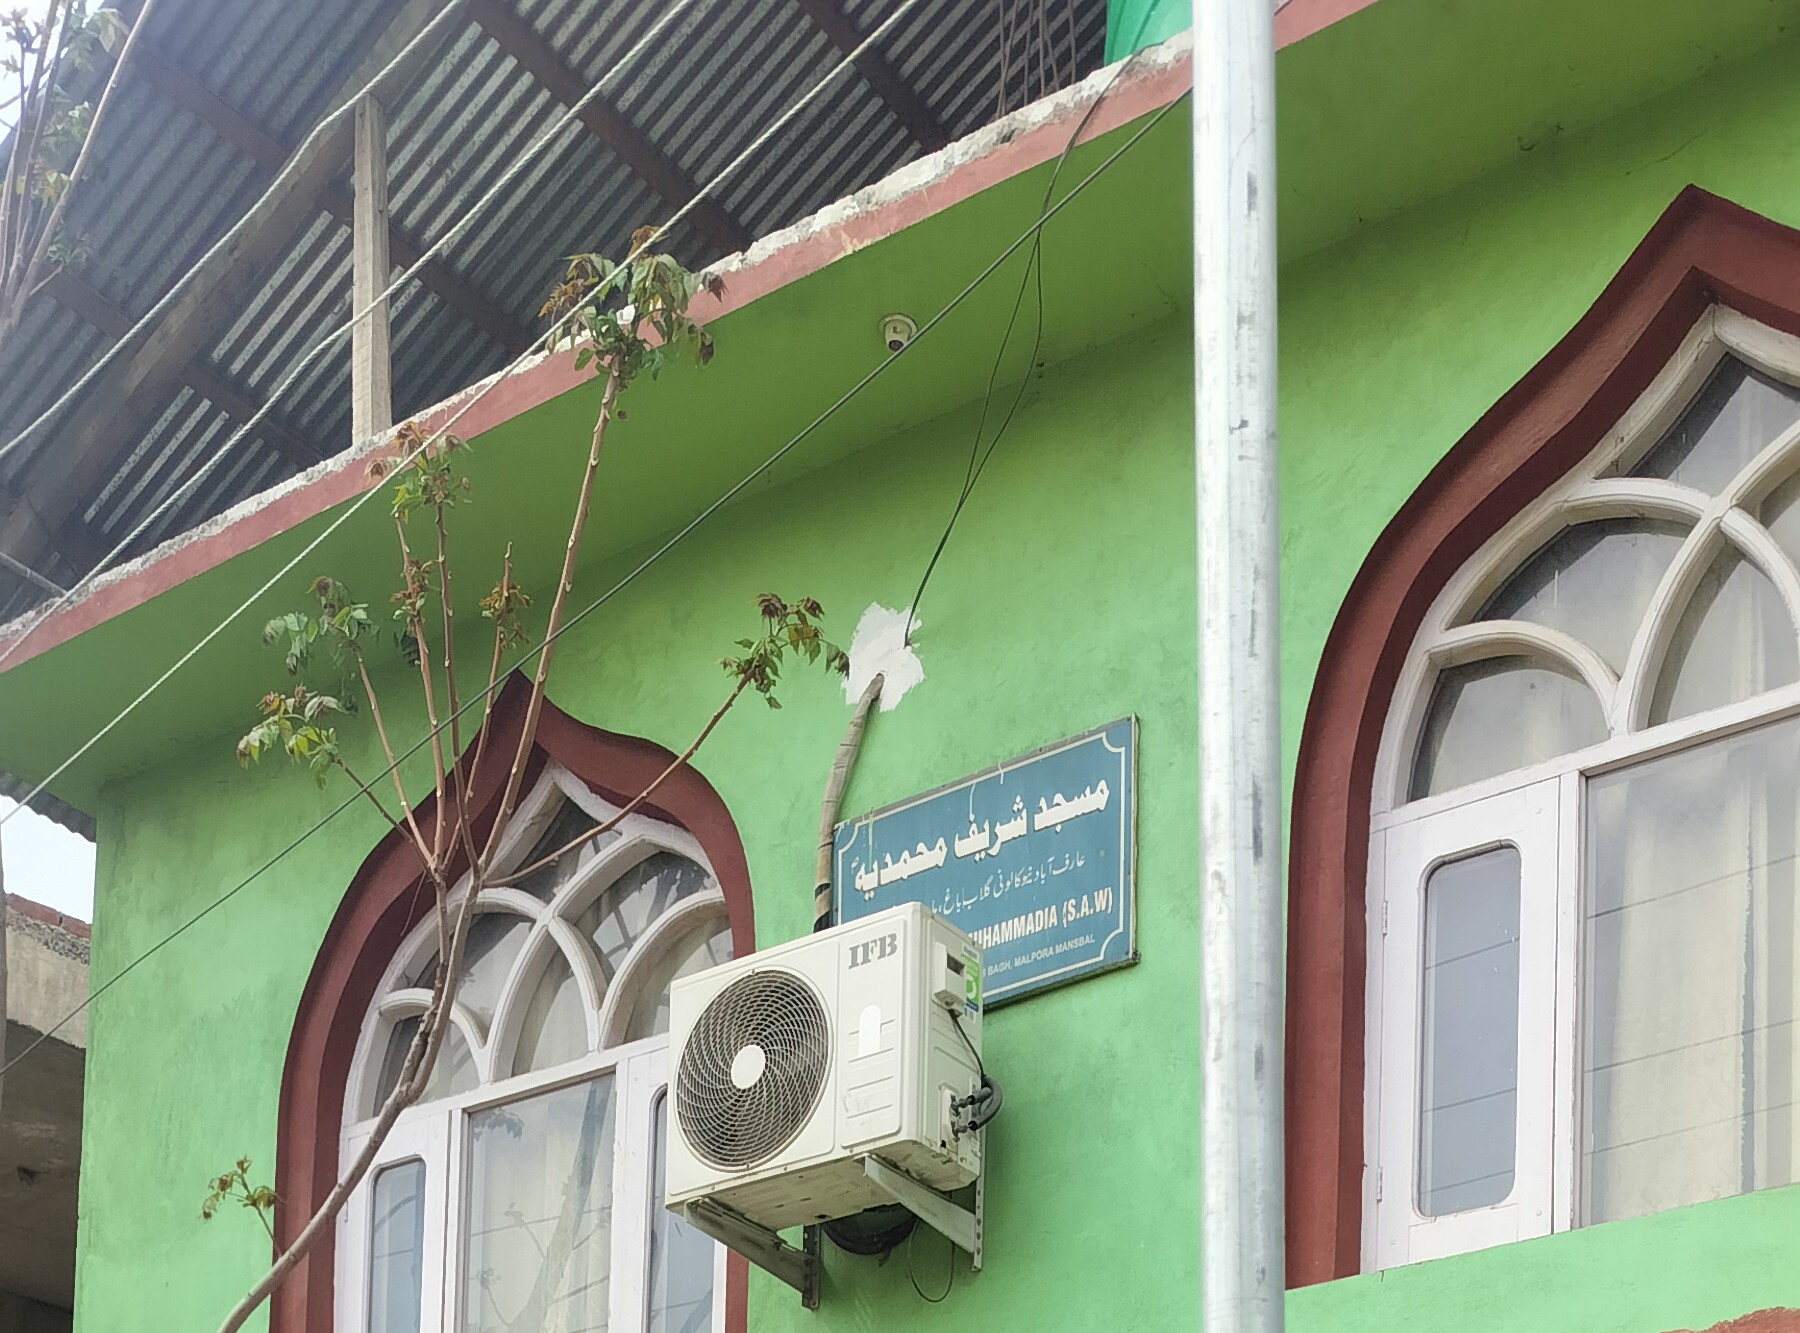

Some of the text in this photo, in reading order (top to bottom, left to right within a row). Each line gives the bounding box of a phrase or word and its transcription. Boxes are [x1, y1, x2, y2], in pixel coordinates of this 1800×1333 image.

[1033, 779, 1110, 832] مسجد
[954, 795, 1027, 862] شریف
[1052, 851, 1086, 875] عارف
[1062, 886, 1113, 928] (S.A.W)
[848, 933, 898, 970] IFB
[987, 962, 1013, 977] BAGH,
[1014, 948, 1055, 968] MALPORA
[1055, 933, 1096, 954] MANSBAL
